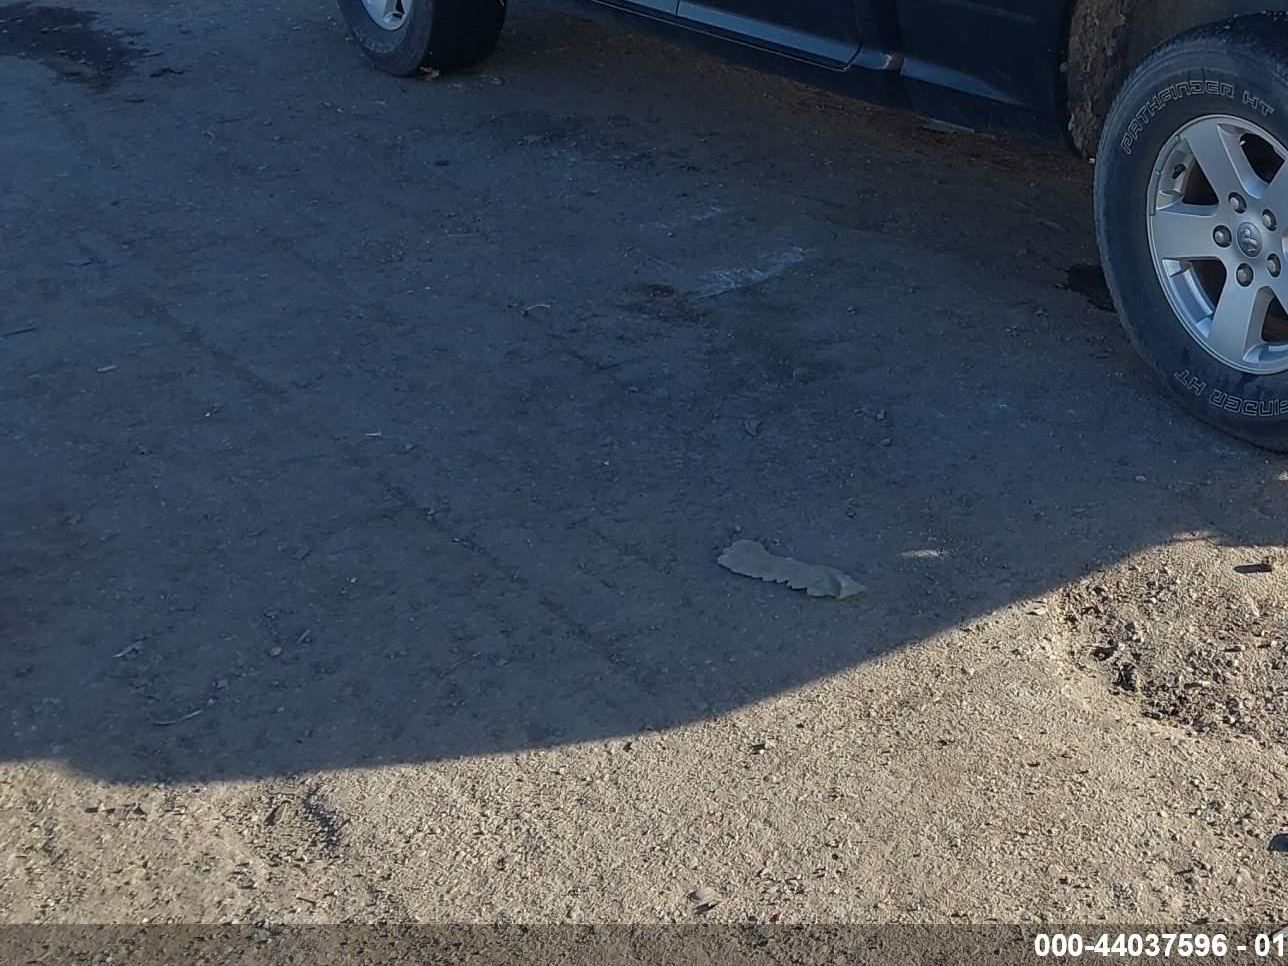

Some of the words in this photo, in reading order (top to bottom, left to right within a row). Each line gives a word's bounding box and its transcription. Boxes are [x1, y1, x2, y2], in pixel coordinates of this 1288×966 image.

[1121, 80, 1235, 155] PATHFINDER
[1242, 90, 1275, 116] HT
[1173, 369, 1207, 396] HT
